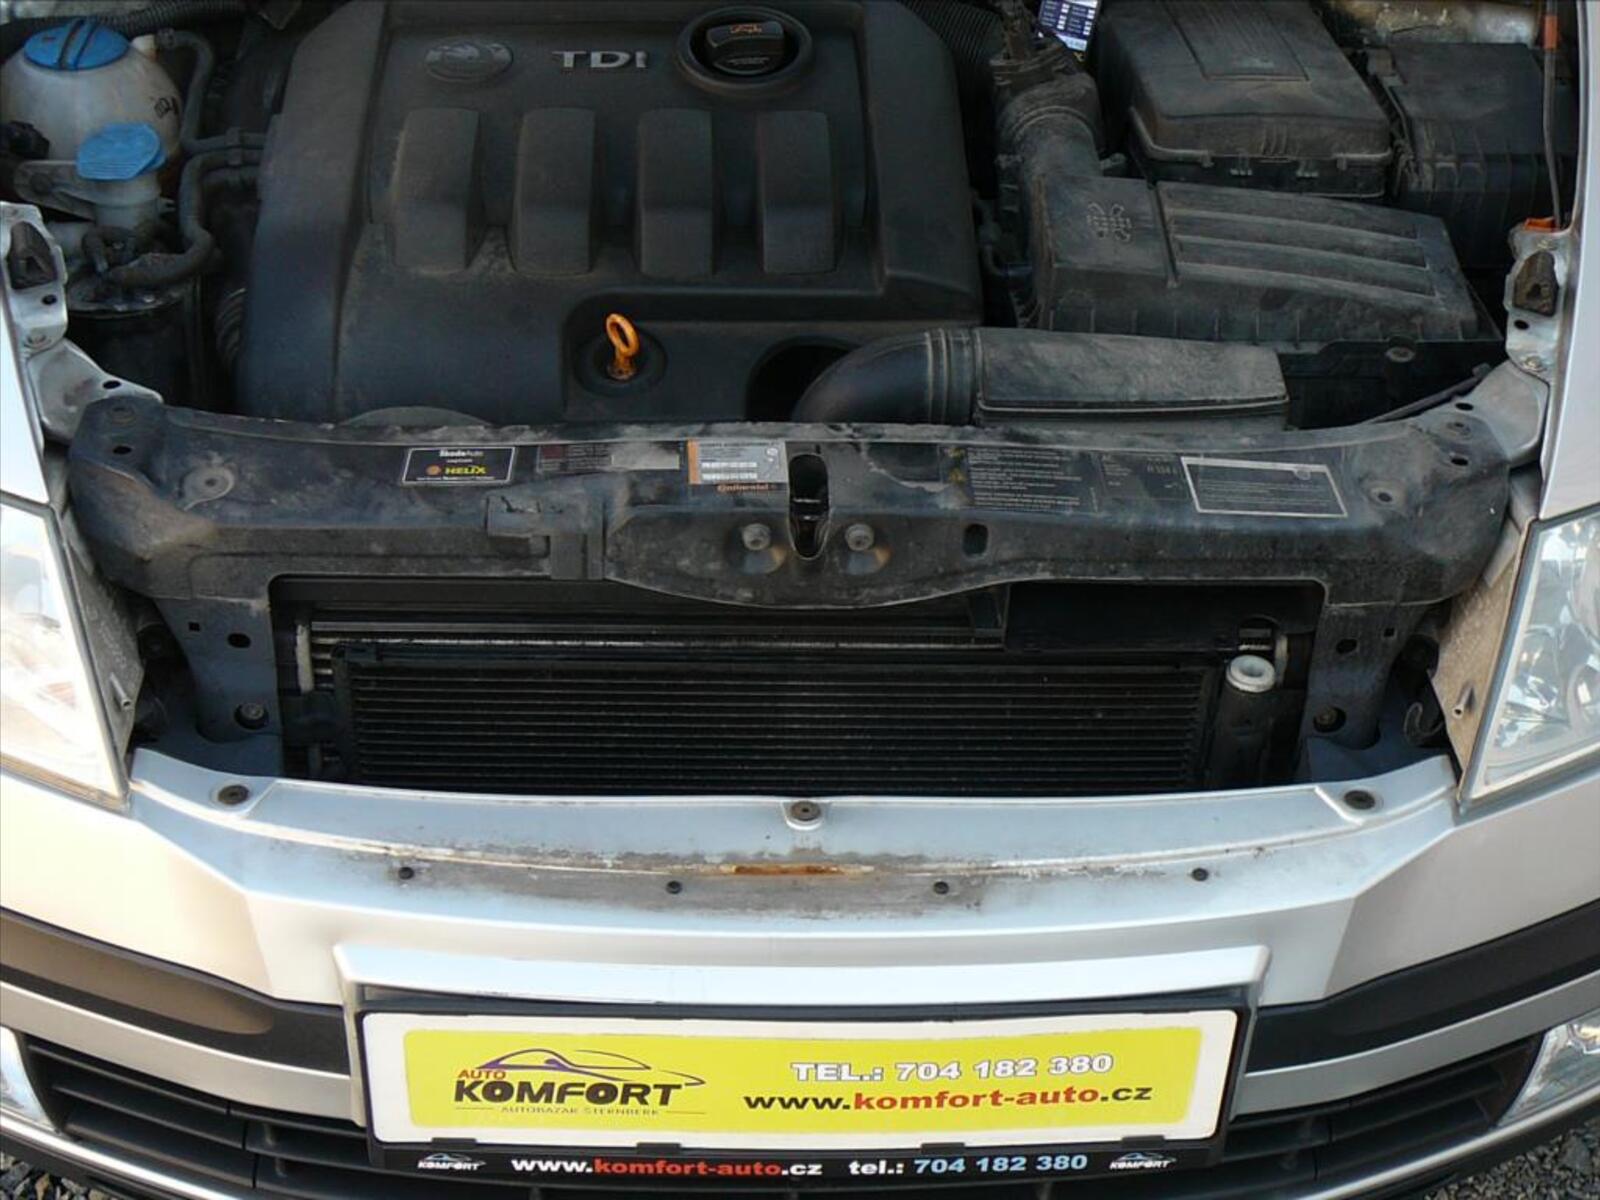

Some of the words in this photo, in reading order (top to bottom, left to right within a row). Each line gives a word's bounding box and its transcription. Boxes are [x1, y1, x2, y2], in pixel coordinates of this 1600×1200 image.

[553, 50, 648, 69] TDI
[457, 1069, 507, 1080] AUTO
[791, 1062, 884, 1082] TEL.:
[896, 1060, 961, 1081] 704
[973, 1057, 1038, 1079] 182
[1048, 1054, 1114, 1076] 380
[454, 1080, 682, 1106] KOMFORT
[743, 1083, 1152, 1112] www.komfort-auto.cz
[510, 1157, 823, 1177] www.komfort-auto.cz
[849, 1160, 904, 1177] tel.:
[914, 1158, 966, 1174] 704
[976, 1156, 1029, 1173] 182
[1036, 1154, 1089, 1171] 380
